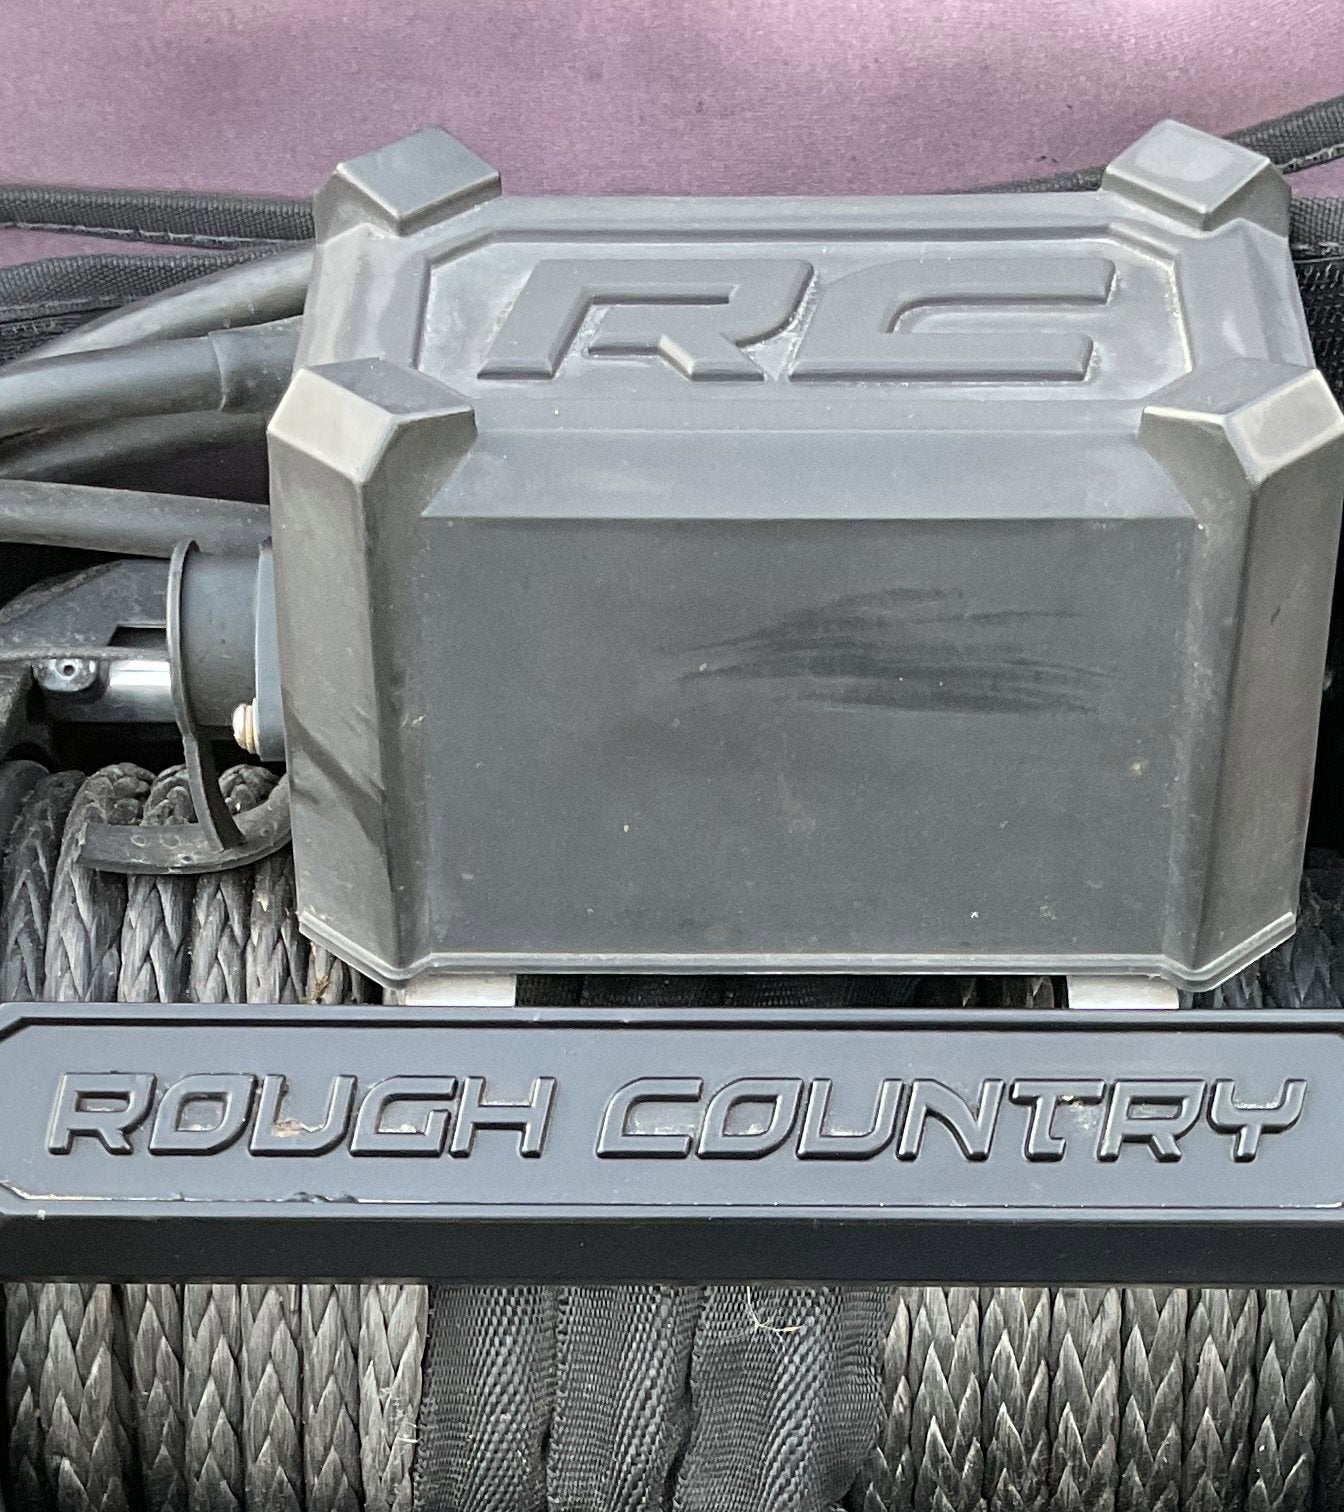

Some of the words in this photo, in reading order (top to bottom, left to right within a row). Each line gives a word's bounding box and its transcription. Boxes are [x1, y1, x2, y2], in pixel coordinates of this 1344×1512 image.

[476, 255, 1117, 382] RC
[47, 1071, 557, 1158] ROUGH
[596, 1076, 1308, 1163] COUNTRY
